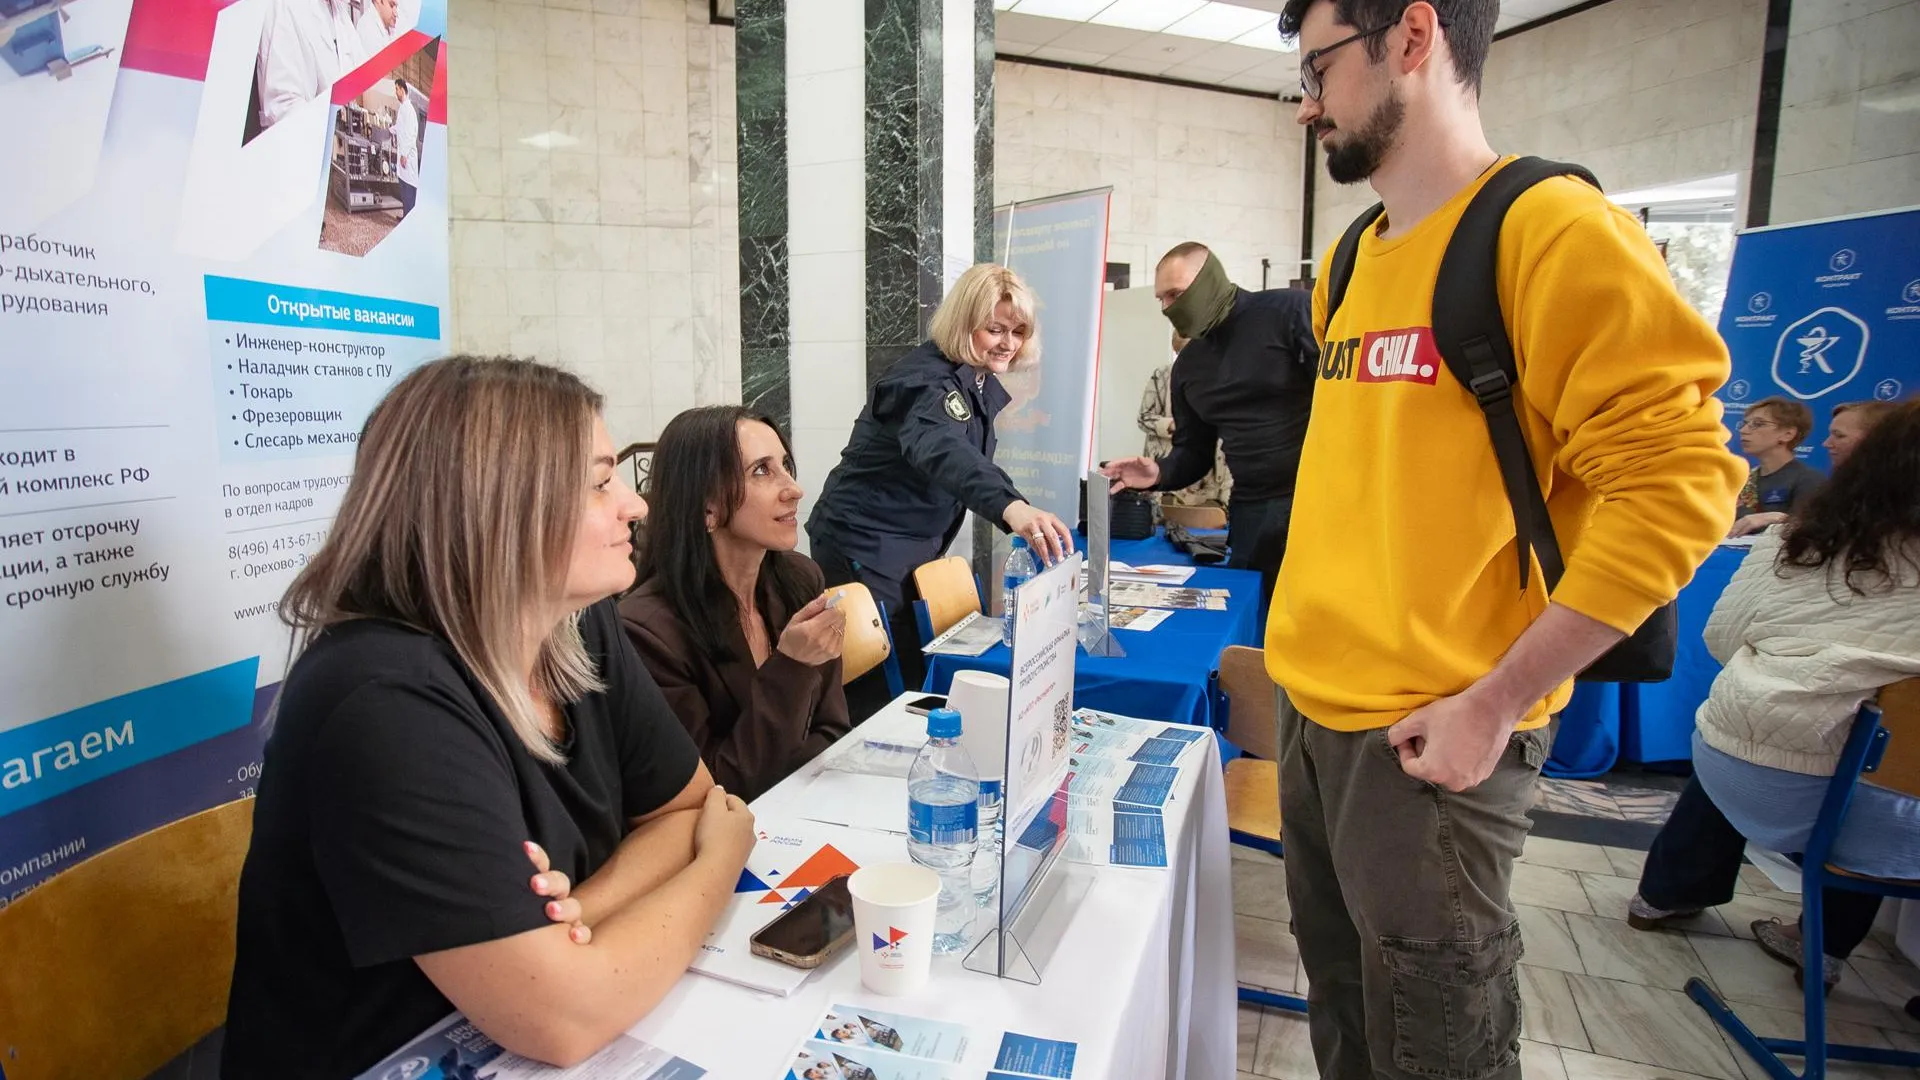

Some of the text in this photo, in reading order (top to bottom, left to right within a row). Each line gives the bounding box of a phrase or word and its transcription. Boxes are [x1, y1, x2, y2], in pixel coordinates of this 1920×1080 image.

[0, 233, 96, 260] работчик
[1, 293, 109, 316] рудования
[267, 294, 415, 328] Открытые вакансии
[236, 333, 386, 358] Инженер-конструктор
[1367, 333, 1434, 378] CHILL.
[238, 358, 393, 378] Наладчик станков с ПУ
[240, 383, 293, 402] Токарь
[242, 408, 342, 427] Фрезеровщик
[245, 433, 303, 450] Слесарь
[64, 449, 75, 461] в
[17, 472, 114, 494] комплекс
[120, 467, 150, 484] РФ
[222, 484, 241, 497] По
[244, 480, 300, 496] вопросам
[225, 497, 314, 518] в отдел кадров
[52, 518, 140, 542] отсрочку
[228, 540, 269, 560] 8(496)
[0, 544, 135, 580] ции, а также
[6, 562, 170, 609] срочную службу
[230, 568, 240, 580] г.
[2, 719, 135, 790] агаем
[237, 761, 263, 782] Обу
[0, 836, 87, 885] омпании
